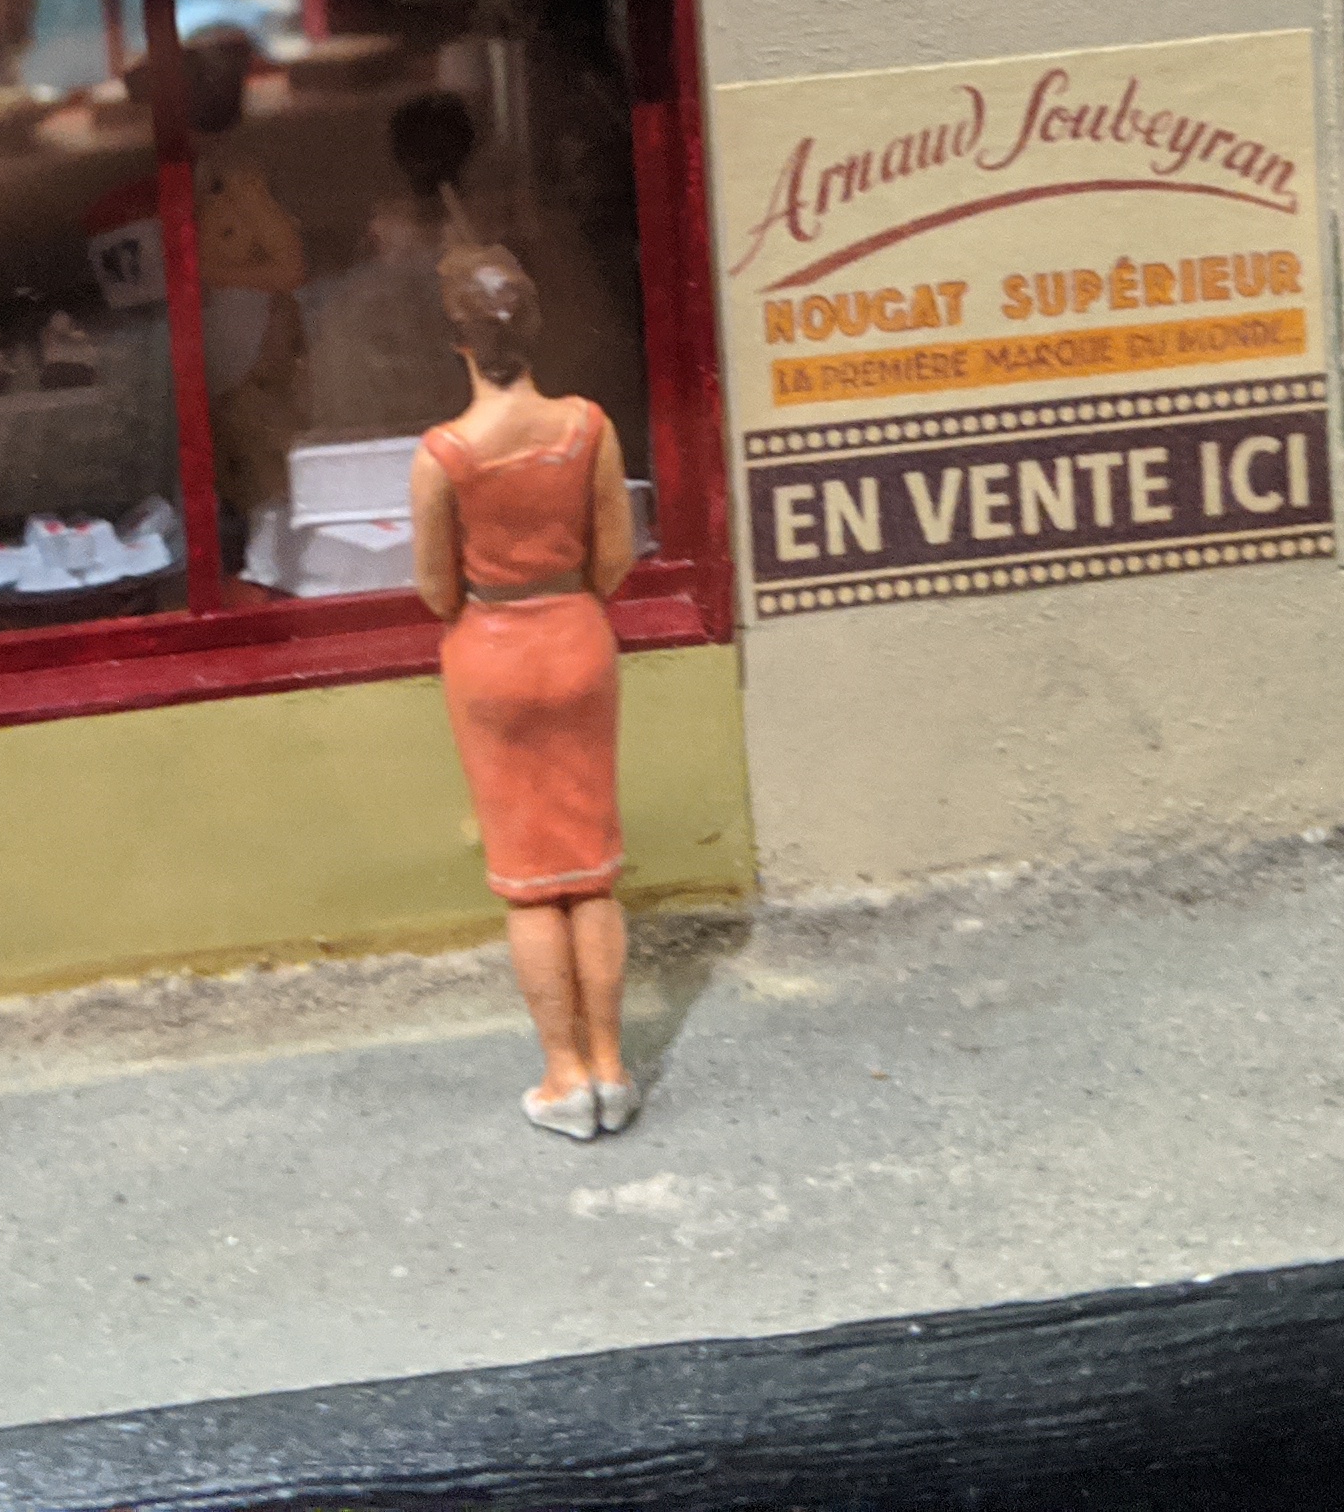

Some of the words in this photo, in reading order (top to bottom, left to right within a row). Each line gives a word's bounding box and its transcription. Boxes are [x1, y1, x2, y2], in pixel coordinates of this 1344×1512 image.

[728, 84, 985, 278] Arnaud
[977, 67, 1298, 198] Soubeyran
[763, 279, 968, 344] NOUGAT
[1000, 249, 1304, 322] SUPÉRIEUR
[772, 476, 884, 563] EN
[903, 445, 1174, 546] VENTE
[1199, 432, 1310, 517] ICI
